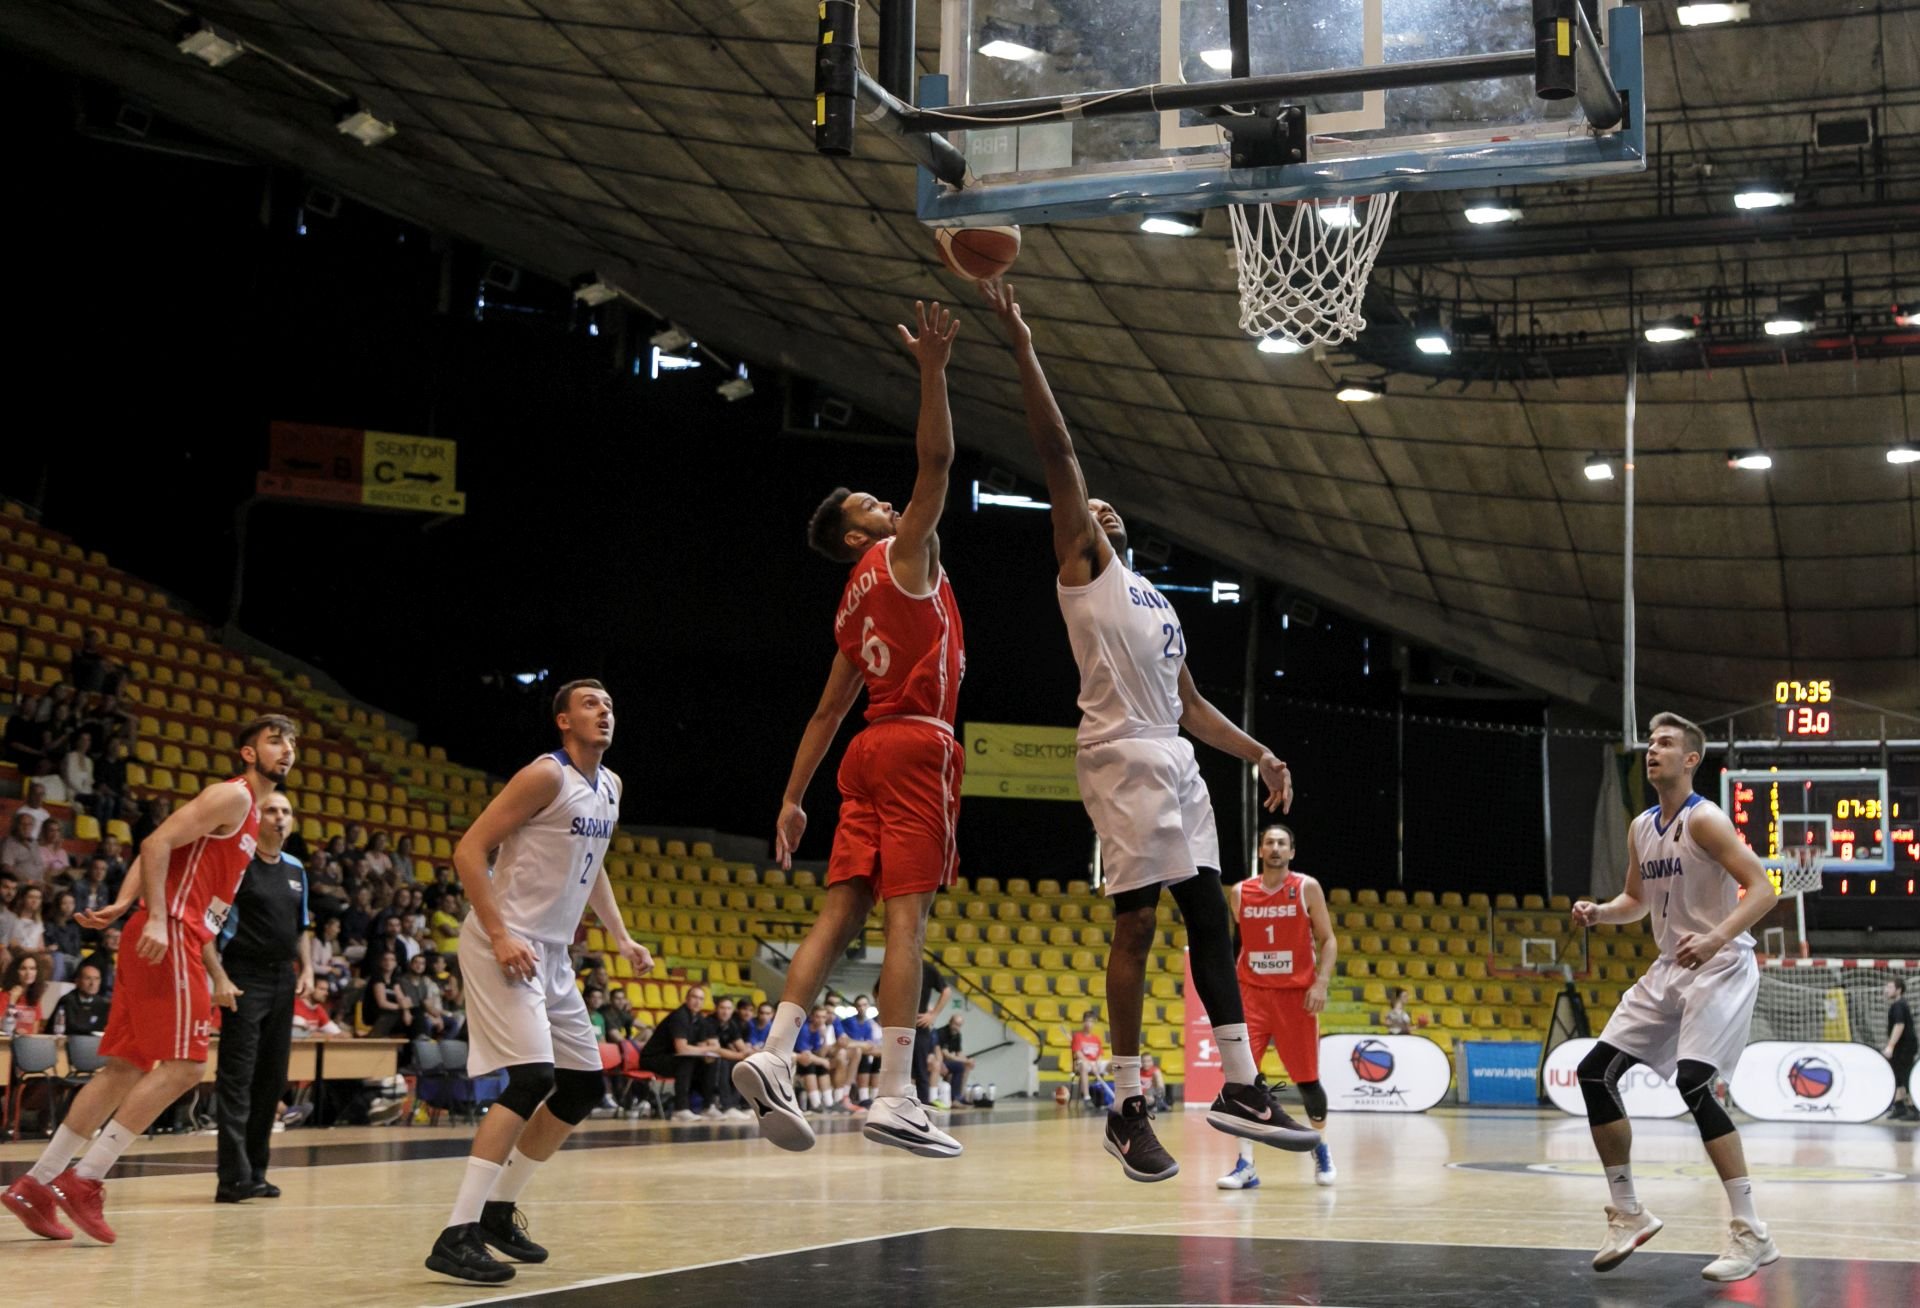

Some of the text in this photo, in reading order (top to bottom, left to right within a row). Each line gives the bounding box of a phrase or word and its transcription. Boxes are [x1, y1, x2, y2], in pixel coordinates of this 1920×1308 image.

[375, 440, 447, 461] SEKTOR
[374, 461, 395, 484] C
[861, 616, 891, 677] 6
[1162, 623, 1184, 658] 21
[1787, 707, 1830, 734] 13.0
[974, 738, 1078, 759] C SEKTOR
[1000, 781, 1009, 793] C
[1841, 842, 1920, 861] 8 4
[580, 852, 593, 884] 2
[1243, 904, 1297, 919] SUISSE
[1265, 924, 1275, 944] 1
[1251, 960, 1293, 970] TISSOT
